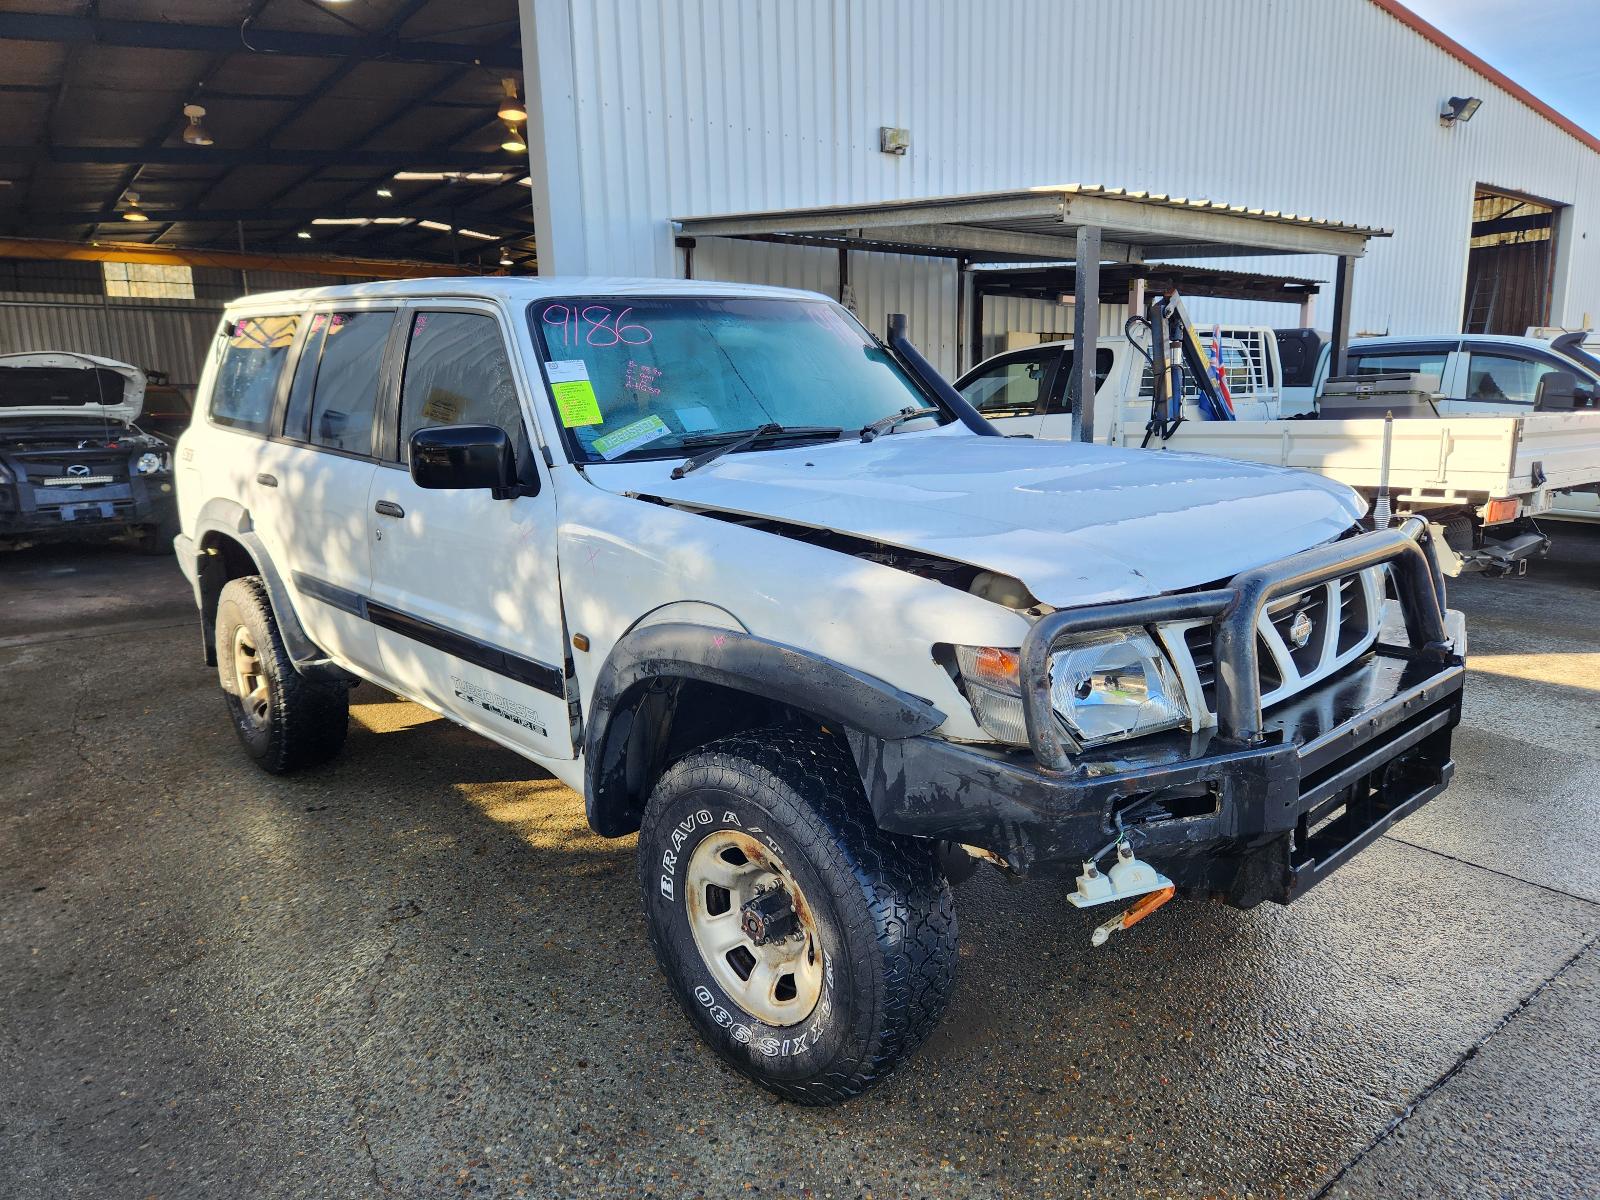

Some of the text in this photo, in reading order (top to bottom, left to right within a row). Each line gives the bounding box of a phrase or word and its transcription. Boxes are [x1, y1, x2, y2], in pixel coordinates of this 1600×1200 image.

[543, 304, 652, 346] 9186
[661, 810, 713, 901] BRAVO
[695, 948, 834, 1057] MAXXIS 980
